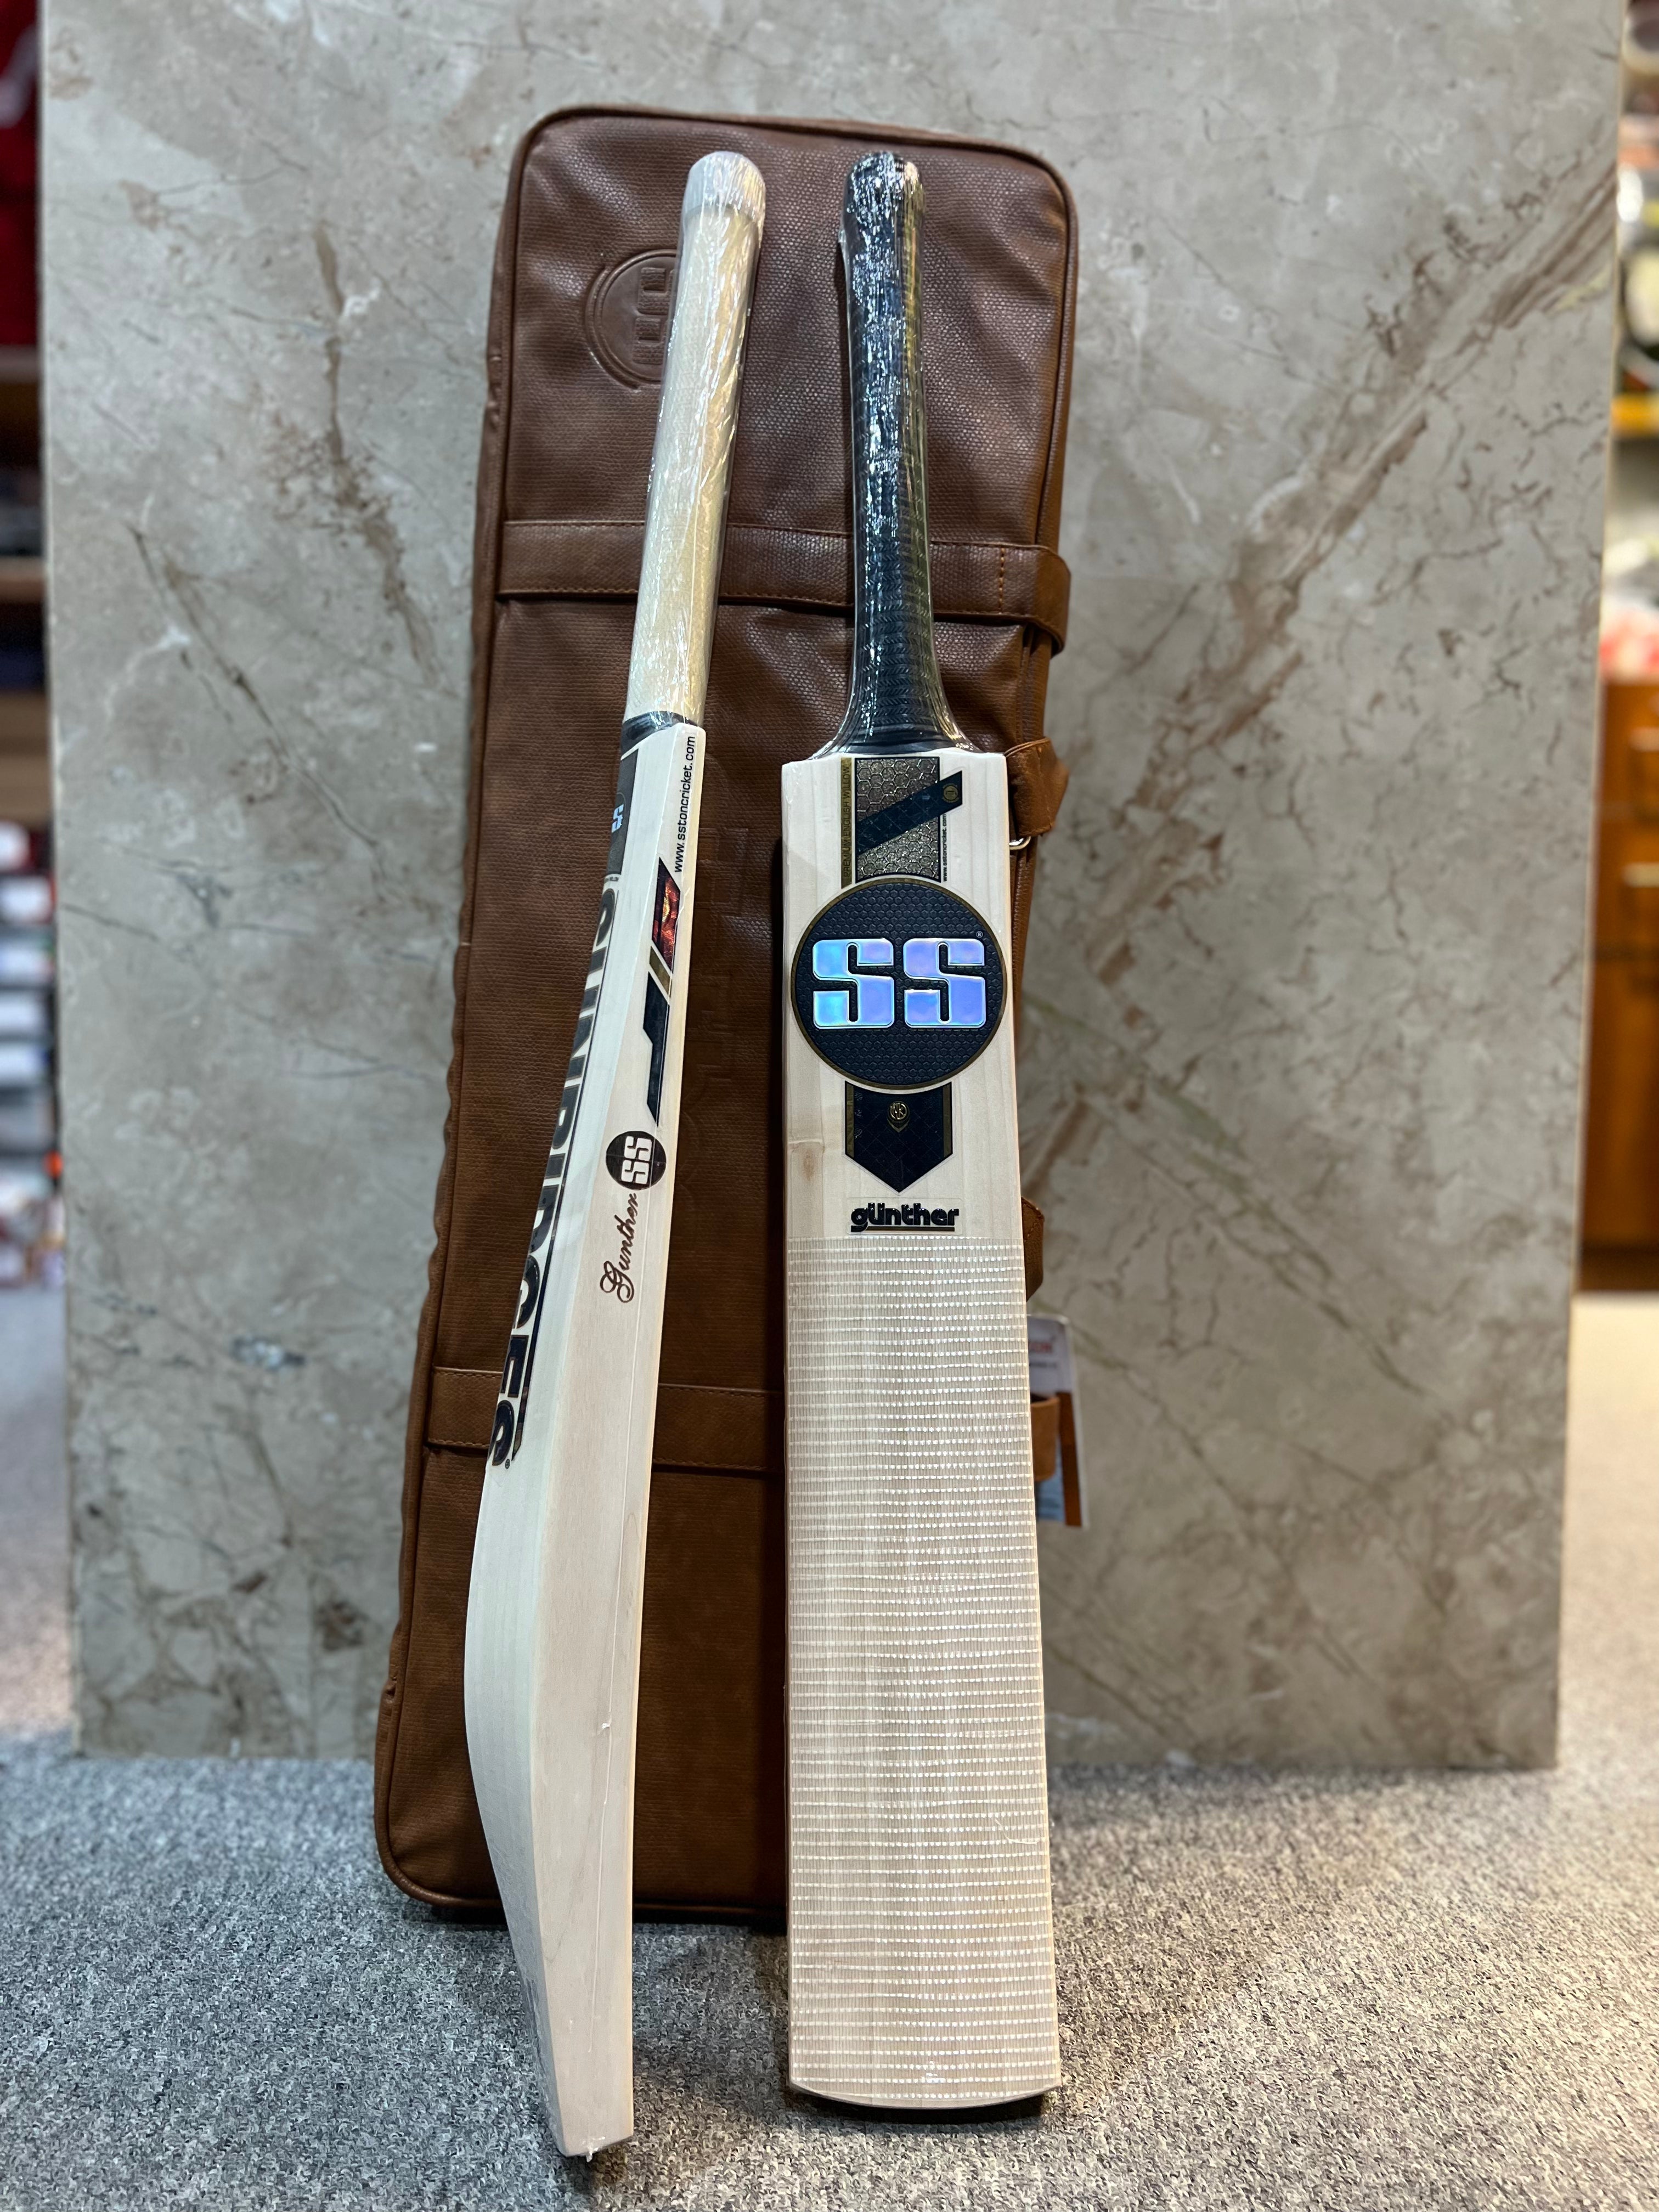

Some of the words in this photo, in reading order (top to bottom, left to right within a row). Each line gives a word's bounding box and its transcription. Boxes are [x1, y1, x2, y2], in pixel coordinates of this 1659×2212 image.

[674, 736, 696, 873] www.sstoncricket.com
[842, 765, 850, 799] WILLOW
[812, 938, 986, 1029] SS
[620, 1135, 653, 1185] SS
[599, 1192, 639, 1304] Gunther
[850, 1202, 960, 1233] günther
